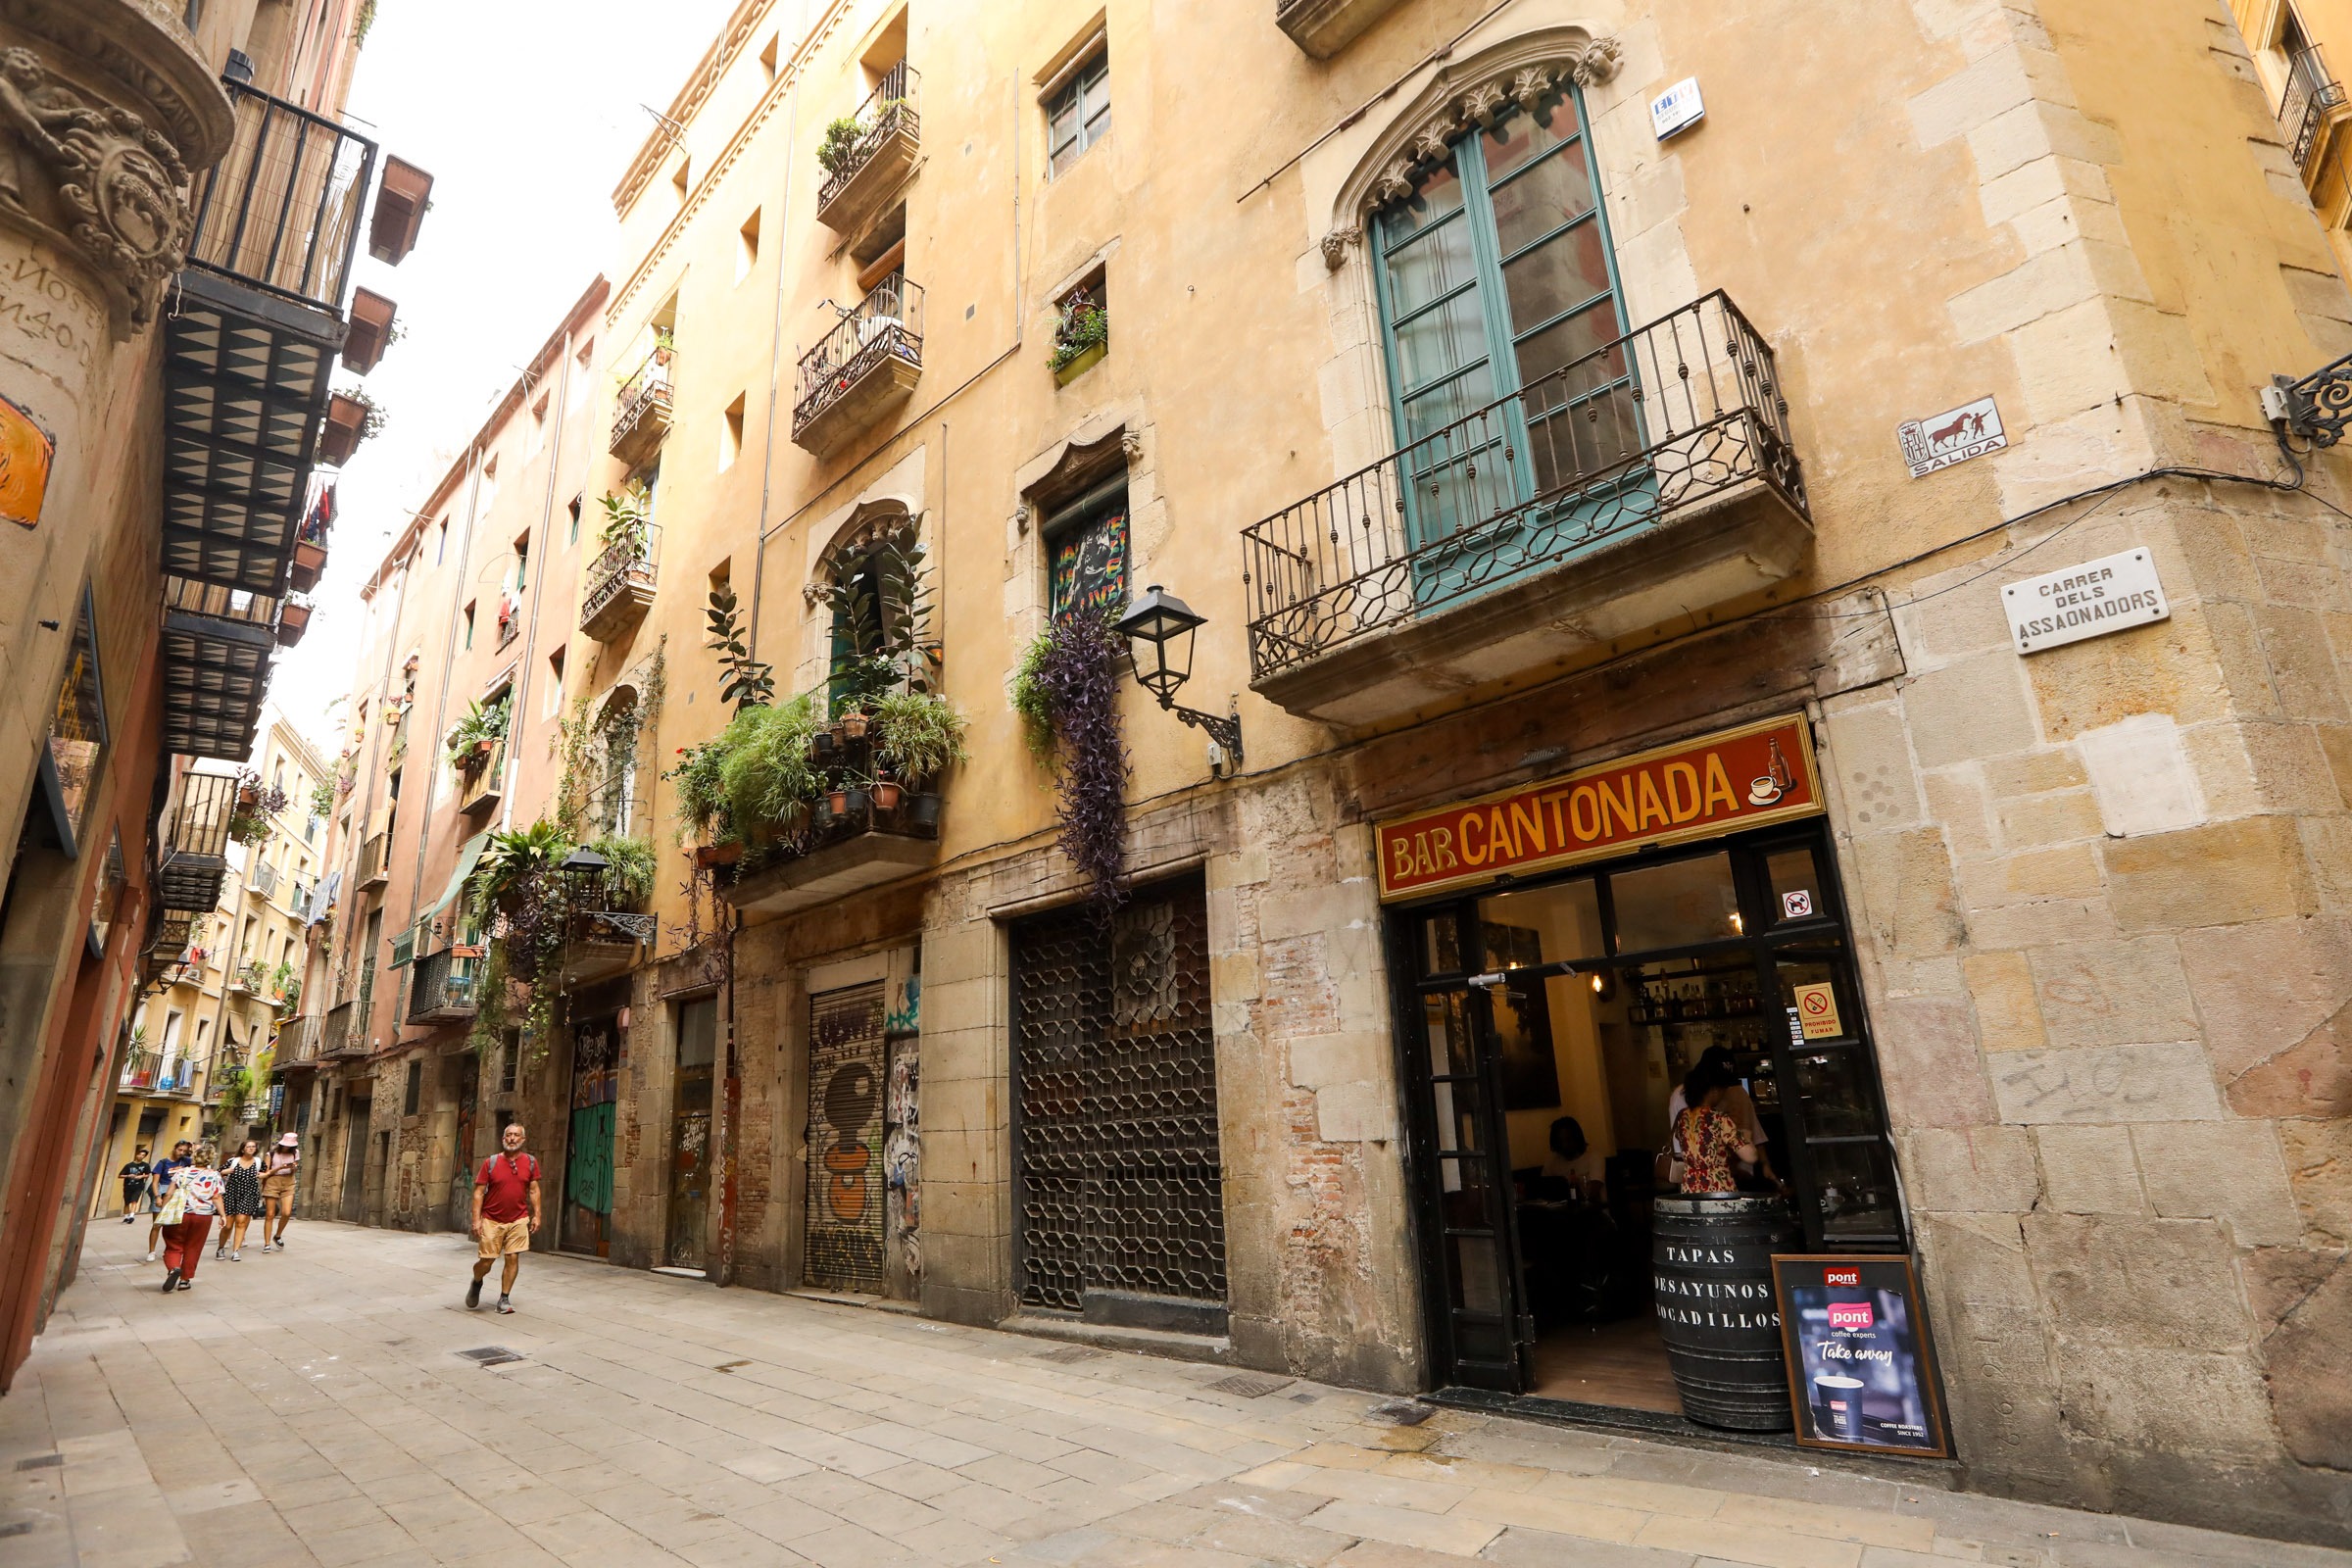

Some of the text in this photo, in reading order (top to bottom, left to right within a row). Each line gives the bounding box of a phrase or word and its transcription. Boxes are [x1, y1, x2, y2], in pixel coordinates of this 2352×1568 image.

[1914, 440, 2001, 475] SALIDA
[2038, 567, 2114, 597] CARRER
[2055, 586, 2106, 609] DELS
[2019, 589, 2158, 639] ASSAONADORS
[1394, 752, 1740, 880] BAR CANTONADA
[1667, 1248, 1735, 1263] TAPAS
[1828, 1273, 1857, 1284] pont
[1833, 1311, 1869, 1325] pont
[1816, 1340, 1893, 1368] Take away
